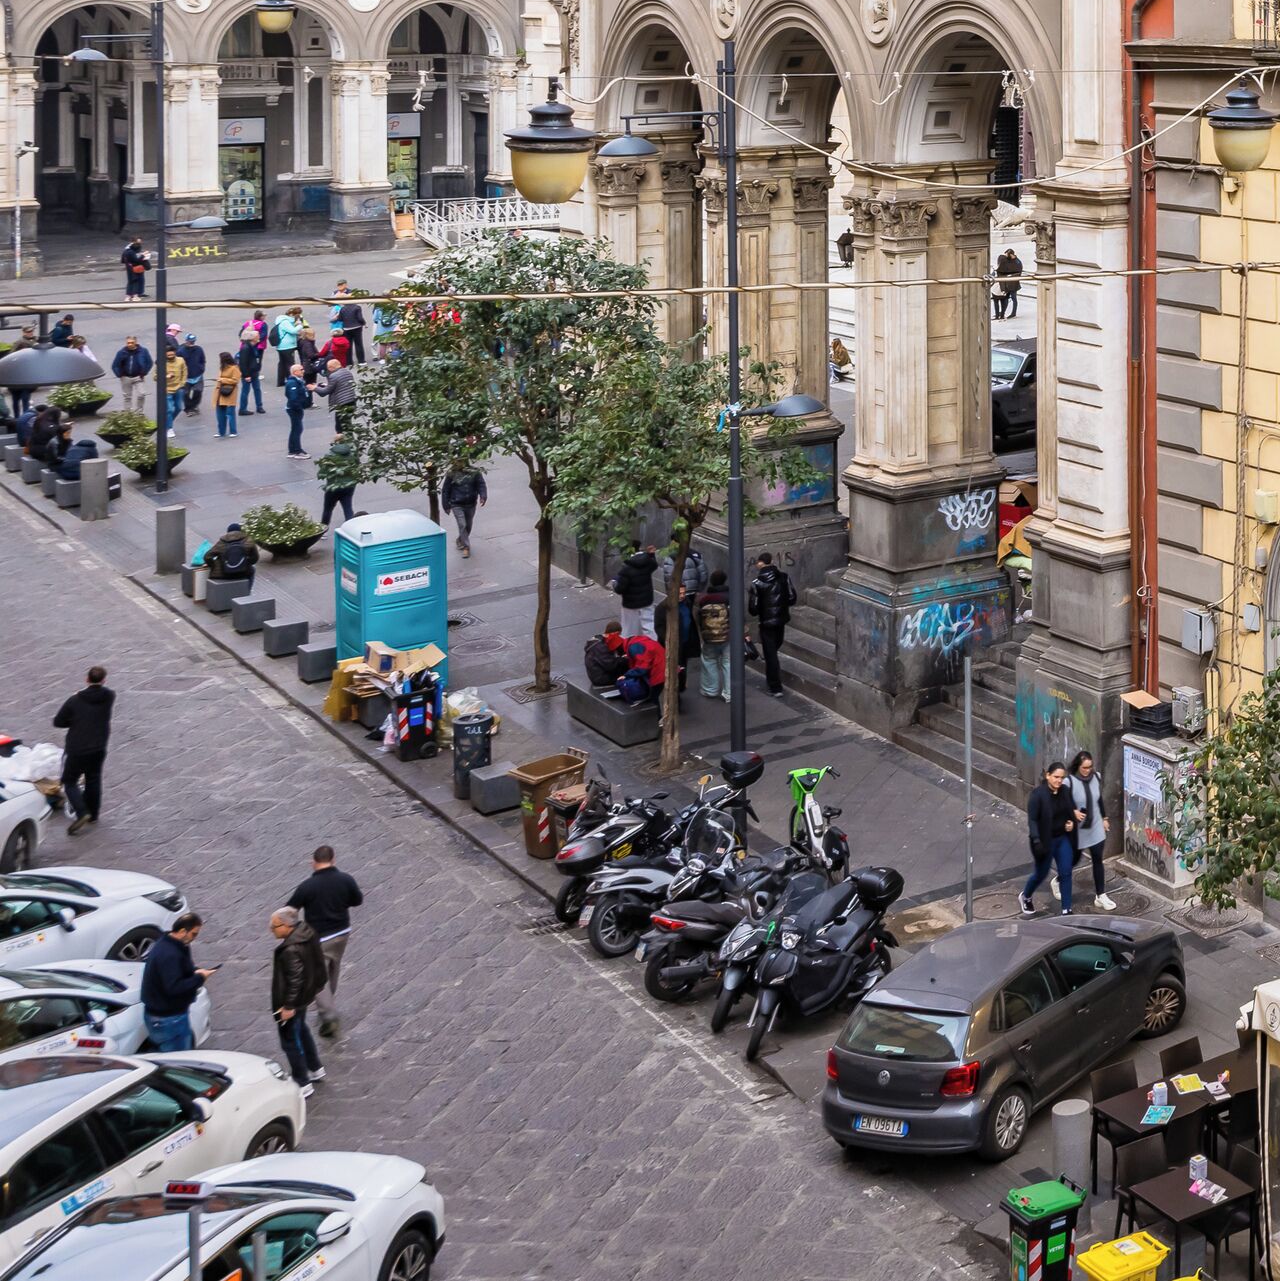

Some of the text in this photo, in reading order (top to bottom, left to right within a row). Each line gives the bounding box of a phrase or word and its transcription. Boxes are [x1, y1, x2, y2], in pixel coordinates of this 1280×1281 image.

[394, 571, 428, 583] SEBACH
[861, 1115, 873, 1129] EN
[168, 1183, 199, 1194] TAXI
